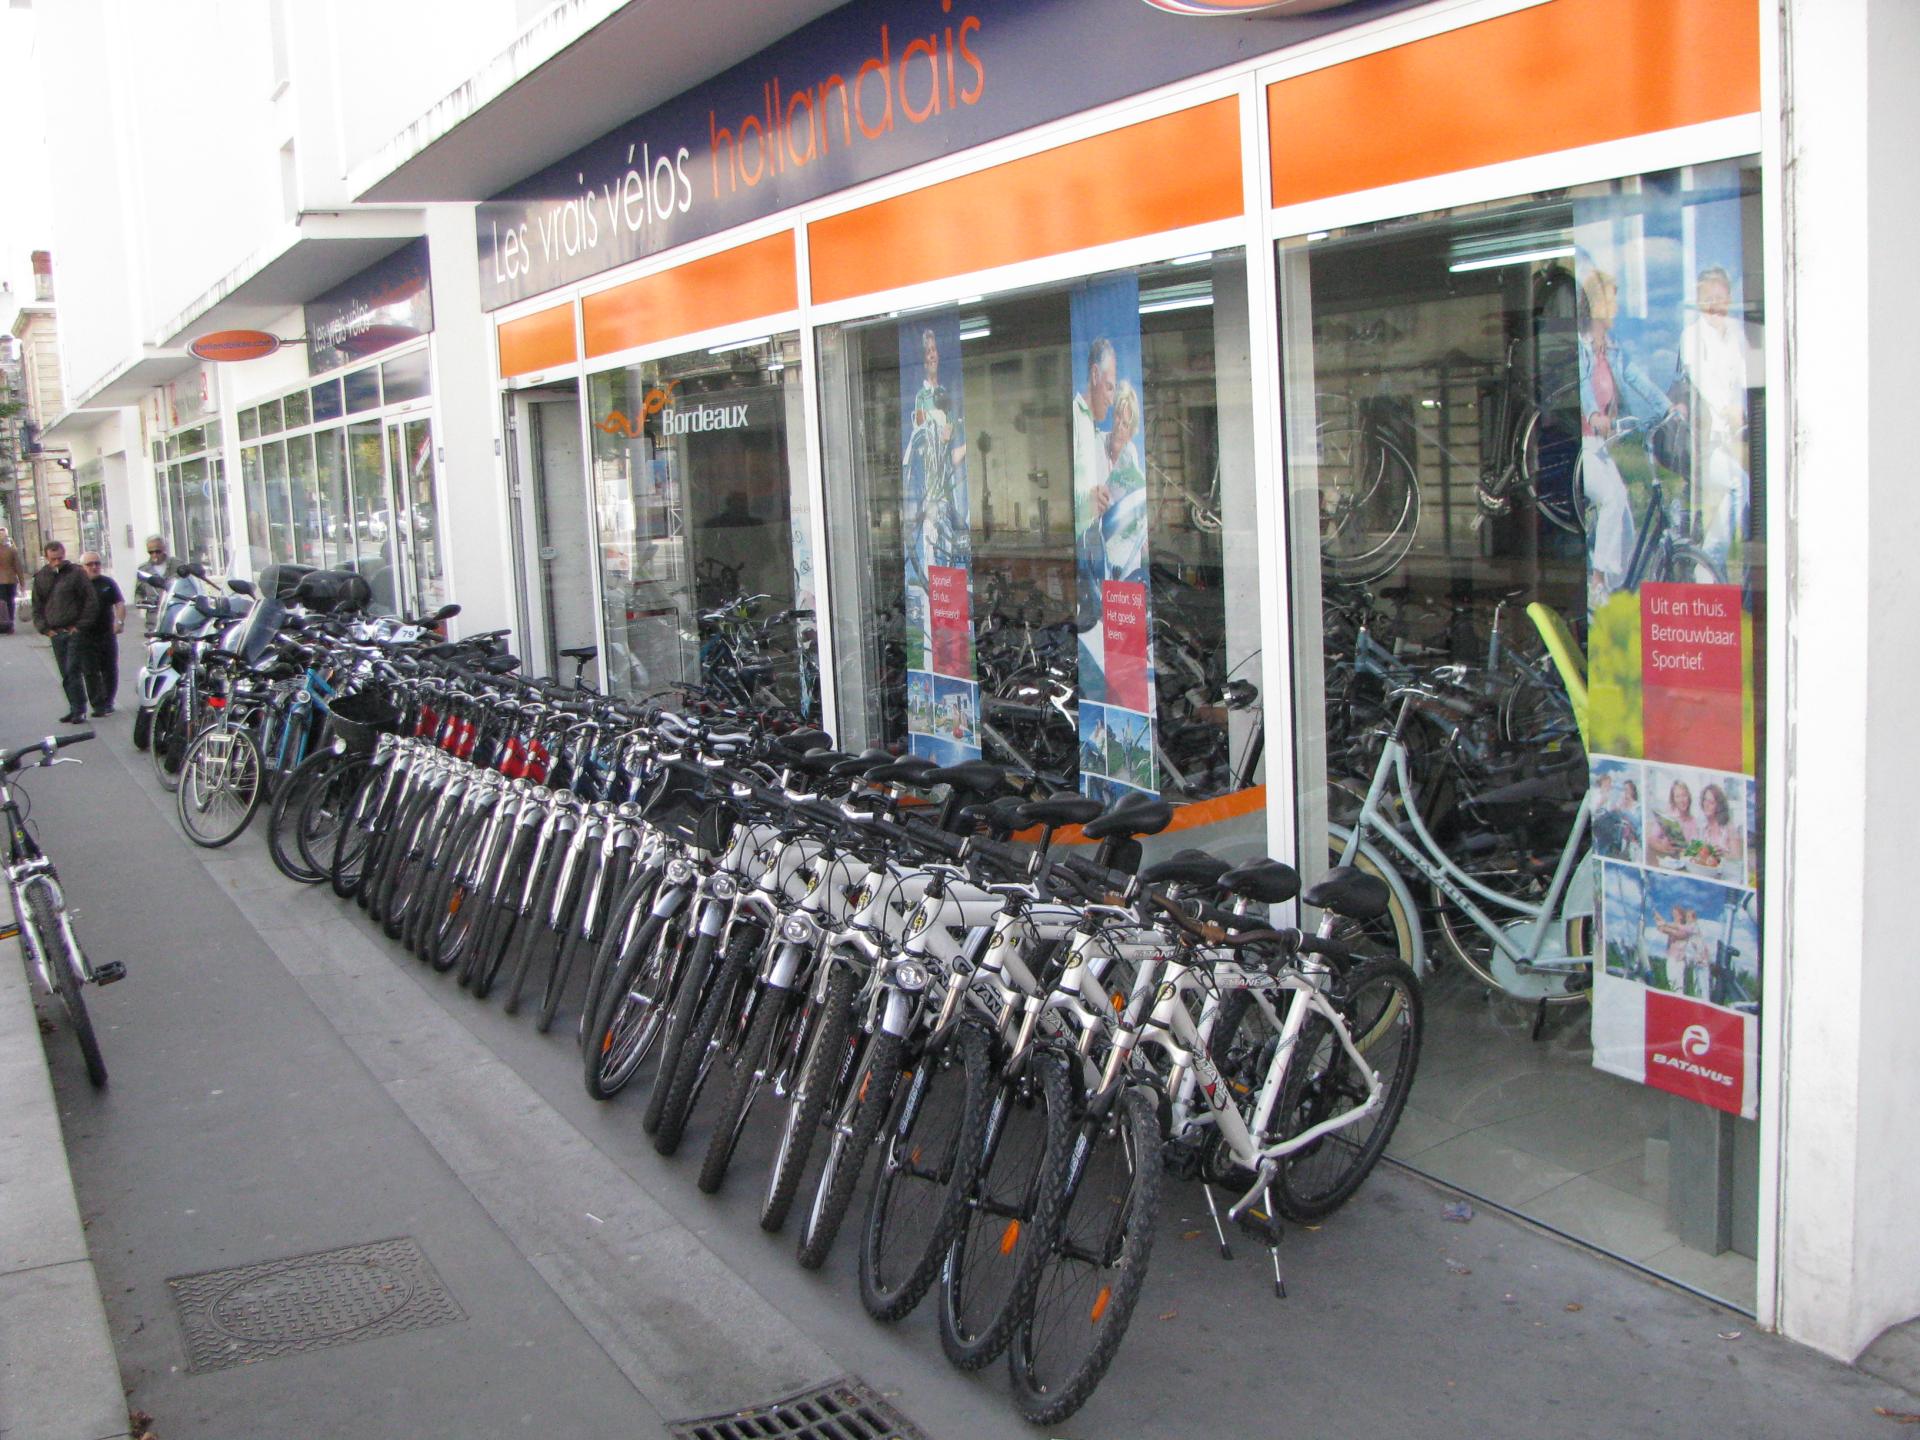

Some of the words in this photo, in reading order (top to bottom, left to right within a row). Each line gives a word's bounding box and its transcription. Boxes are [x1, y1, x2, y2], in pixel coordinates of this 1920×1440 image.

[493, 220, 529, 284] Les
[537, 173, 598, 265] vrais
[603, 143, 693, 239] vélos
[709, 0, 986, 198] hollandais
[662, 404, 748, 436] Bordeaux
[1650, 597, 1669, 615] Uit
[1672, 601, 1688, 616] en
[1693, 598, 1727, 617] thuis.
[402, 630, 415, 639] 79
[1651, 623, 1737, 646] Betrouwbaar.
[1652, 650, 1705, 672] Sportief.
[1652, 1053, 1734, 1086] BATAVUS
